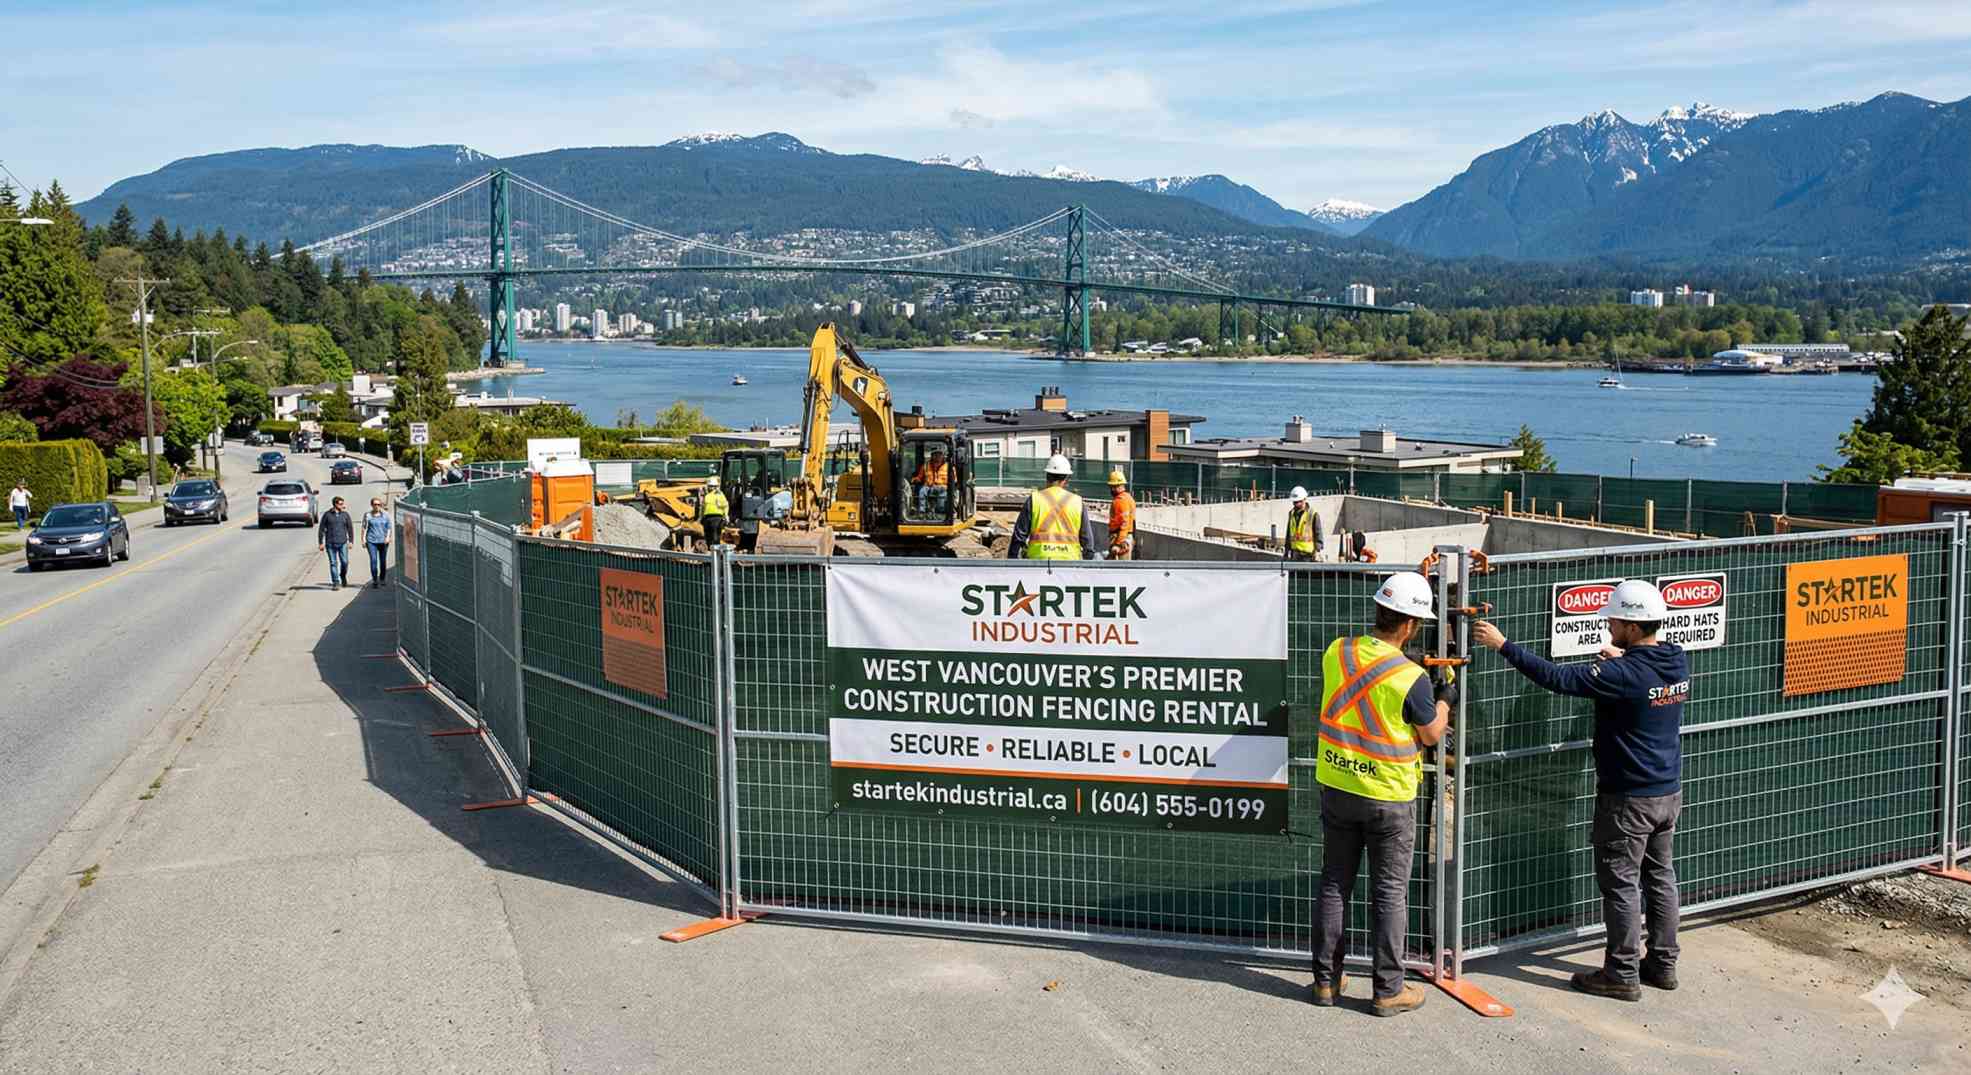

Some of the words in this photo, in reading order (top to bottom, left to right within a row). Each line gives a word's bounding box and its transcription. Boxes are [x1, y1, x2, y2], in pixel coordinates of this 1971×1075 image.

[605, 584, 658, 617] STARTEK
[961, 580, 1148, 619] STARTEK
[1564, 591, 1610, 608] DANGE
[1666, 585, 1717, 602] DANGER
[1797, 574, 1897, 607] STARTEK
[1555, 619, 1608, 634] CONSTRUCT
[1662, 615, 1691, 630] HARD
[1694, 613, 1720, 626] HATS
[1806, 603, 1890, 626] INDUSTRIAL
[972, 621, 1139, 645] INDUSTRIAL
[1577, 632, 1602, 645] AREA
[1665, 628, 1716, 644] REQUIRED
[862, 658, 931, 683] WEST
[938, 661, 1116, 689] VANCOUVER'S
[1123, 667, 1243, 693] PREMIER
[843, 688, 1034, 719] CONSTRUCTION
[1042, 696, 1155, 722] FENCING
[1163, 702, 1268, 728] RENTAL
[889, 733, 979, 758] SECURE
[1001, 737, 1116, 764] RELIABLE
[1138, 744, 1217, 768] LOCAL
[1325, 749, 1377, 776] Startek
[852, 779, 1067, 811] startekindustrial.ca
[1091, 789, 1149, 817] (604)
[1155, 795, 1265, 821] 555-0199
